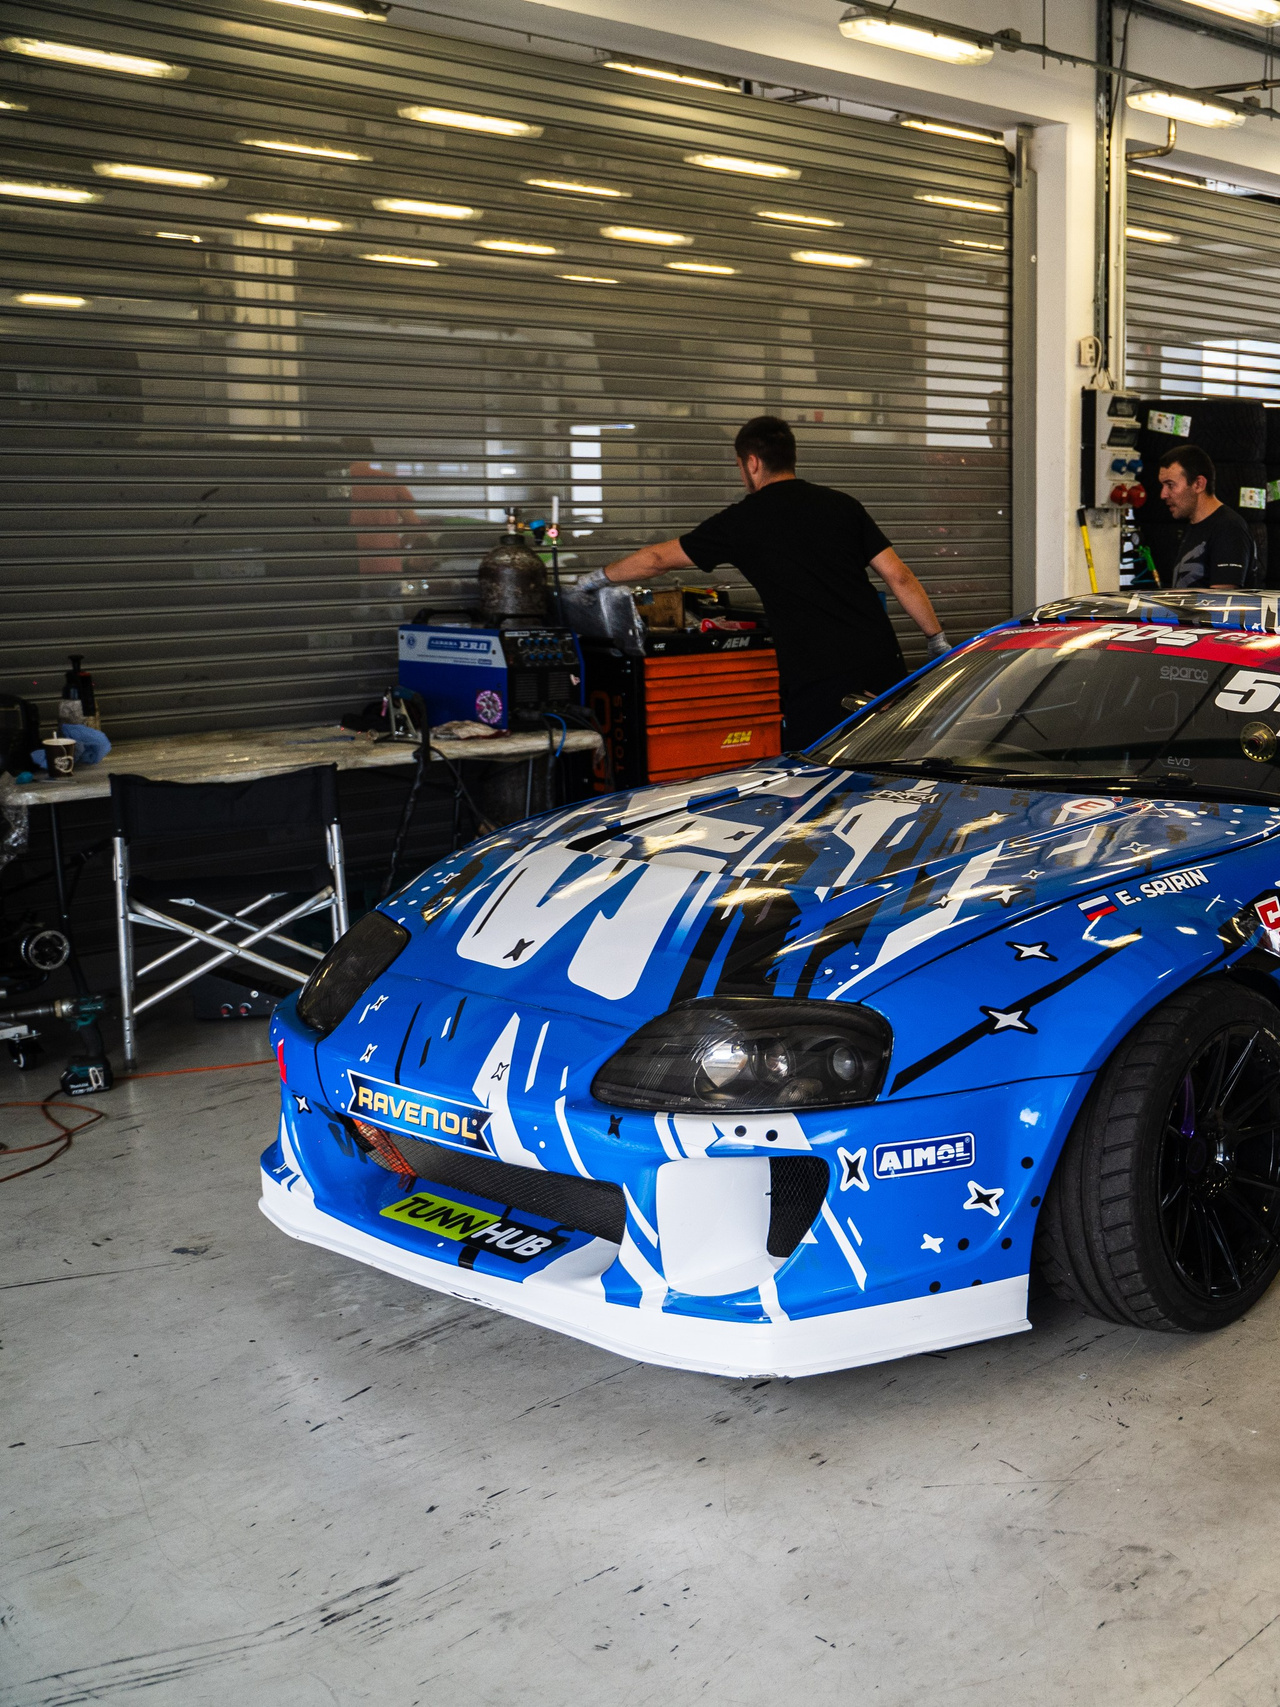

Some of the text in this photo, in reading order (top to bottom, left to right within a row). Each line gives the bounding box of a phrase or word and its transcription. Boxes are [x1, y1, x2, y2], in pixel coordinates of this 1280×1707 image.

[722, 636, 751, 649] AEM
[1098, 623, 1213, 647] RDS
[1160, 664, 1209, 682] sparco
[613, 695, 625, 773] TOOLS
[722, 730, 752, 745] AEM
[1167, 756, 1191, 767] EVO
[1115, 868, 1210, 906] E. SPIRIN
[358, 1085, 478, 1141] RAVENOL
[878, 1141, 971, 1172] AIMOL
